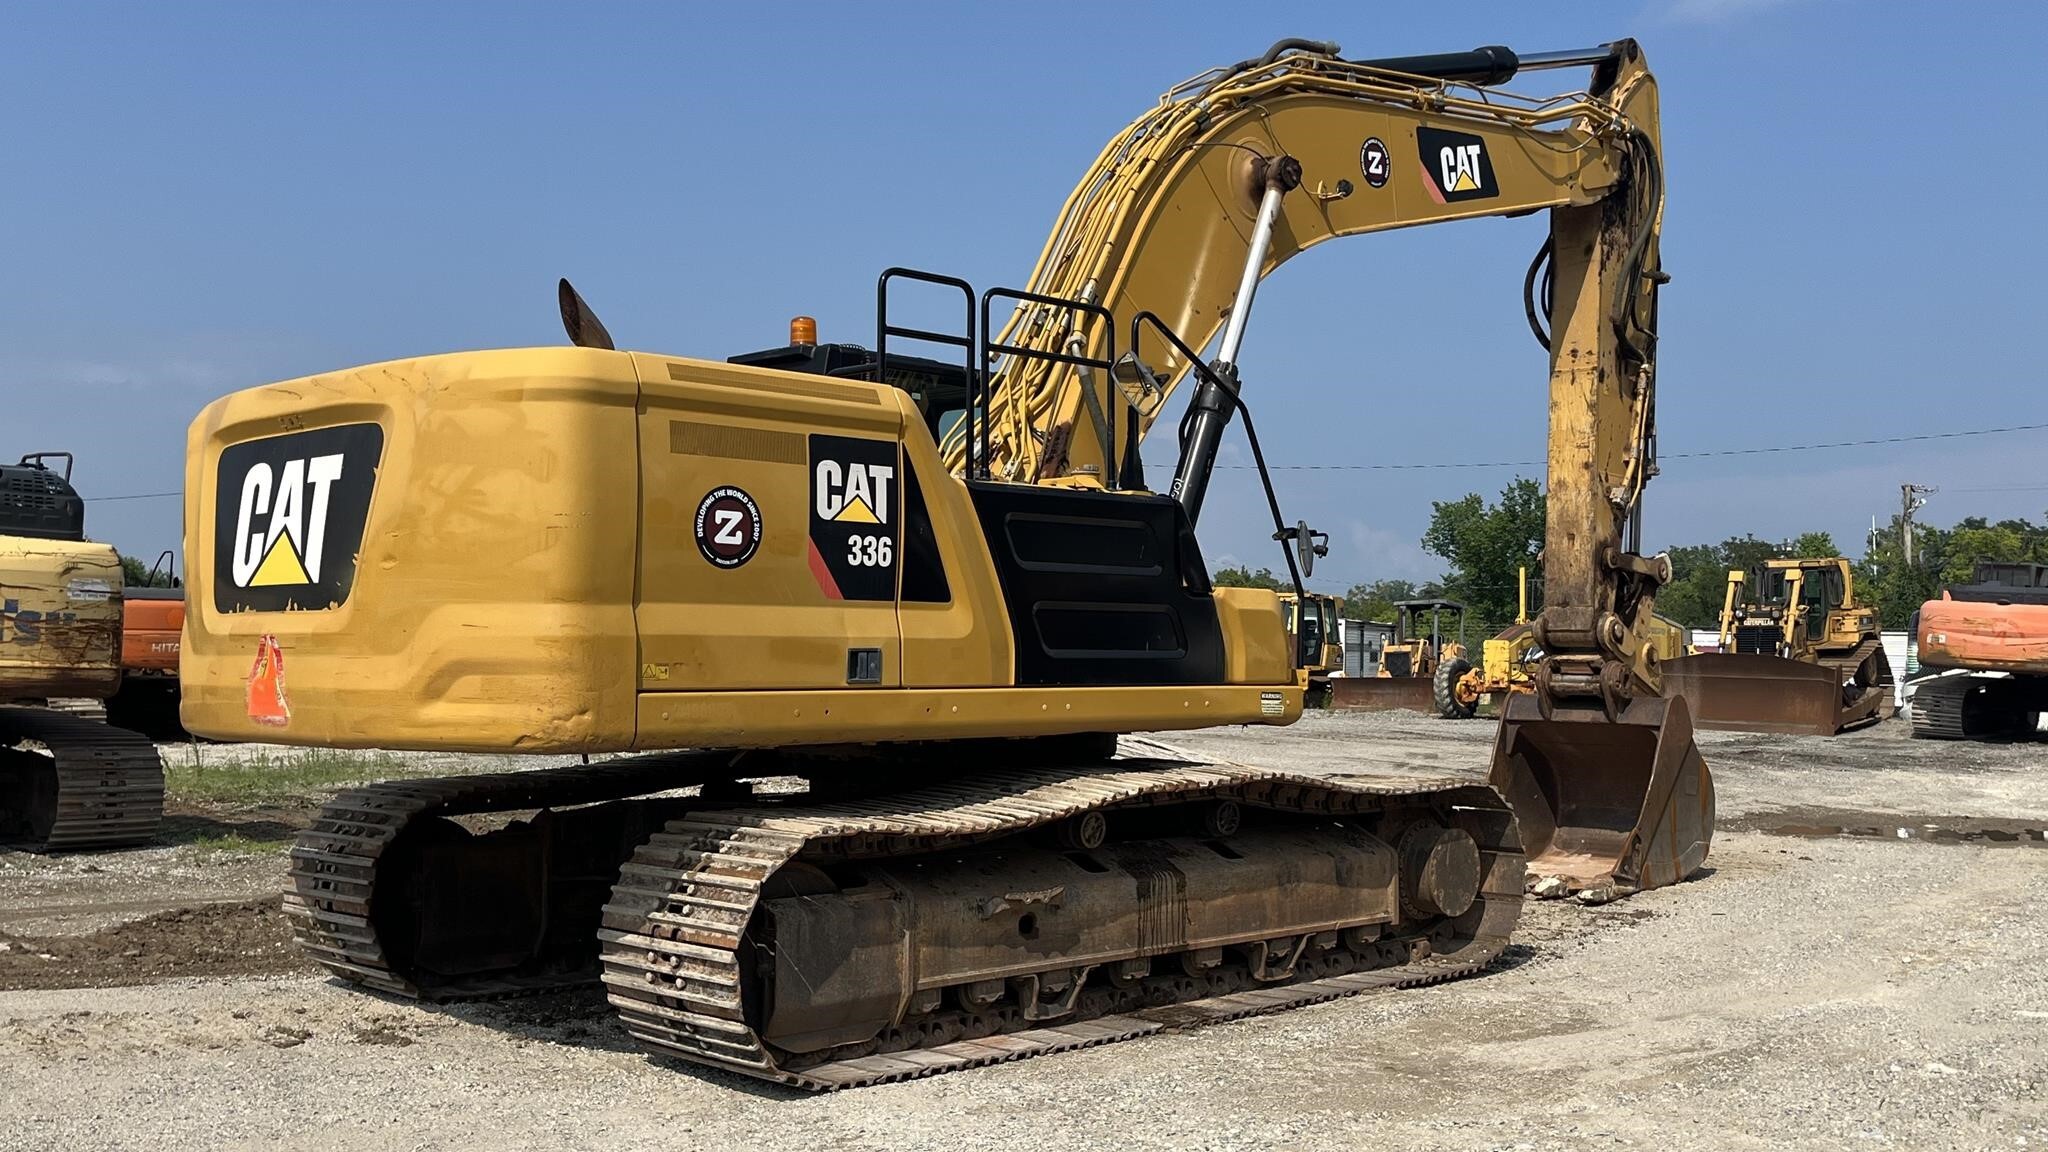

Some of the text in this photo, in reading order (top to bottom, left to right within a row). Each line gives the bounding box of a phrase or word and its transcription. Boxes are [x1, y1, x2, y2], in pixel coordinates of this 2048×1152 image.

[1367, 150, 1383, 175] Z
[1440, 145, 1481, 192] CAT
[697, 488, 761, 542] DEVELOPING THE WORLD SINCE 2007
[816, 459, 893, 525] CAT
[232, 453, 345, 588] CAT
[713, 509, 743, 546] Z
[847, 534, 893, 568] 336
